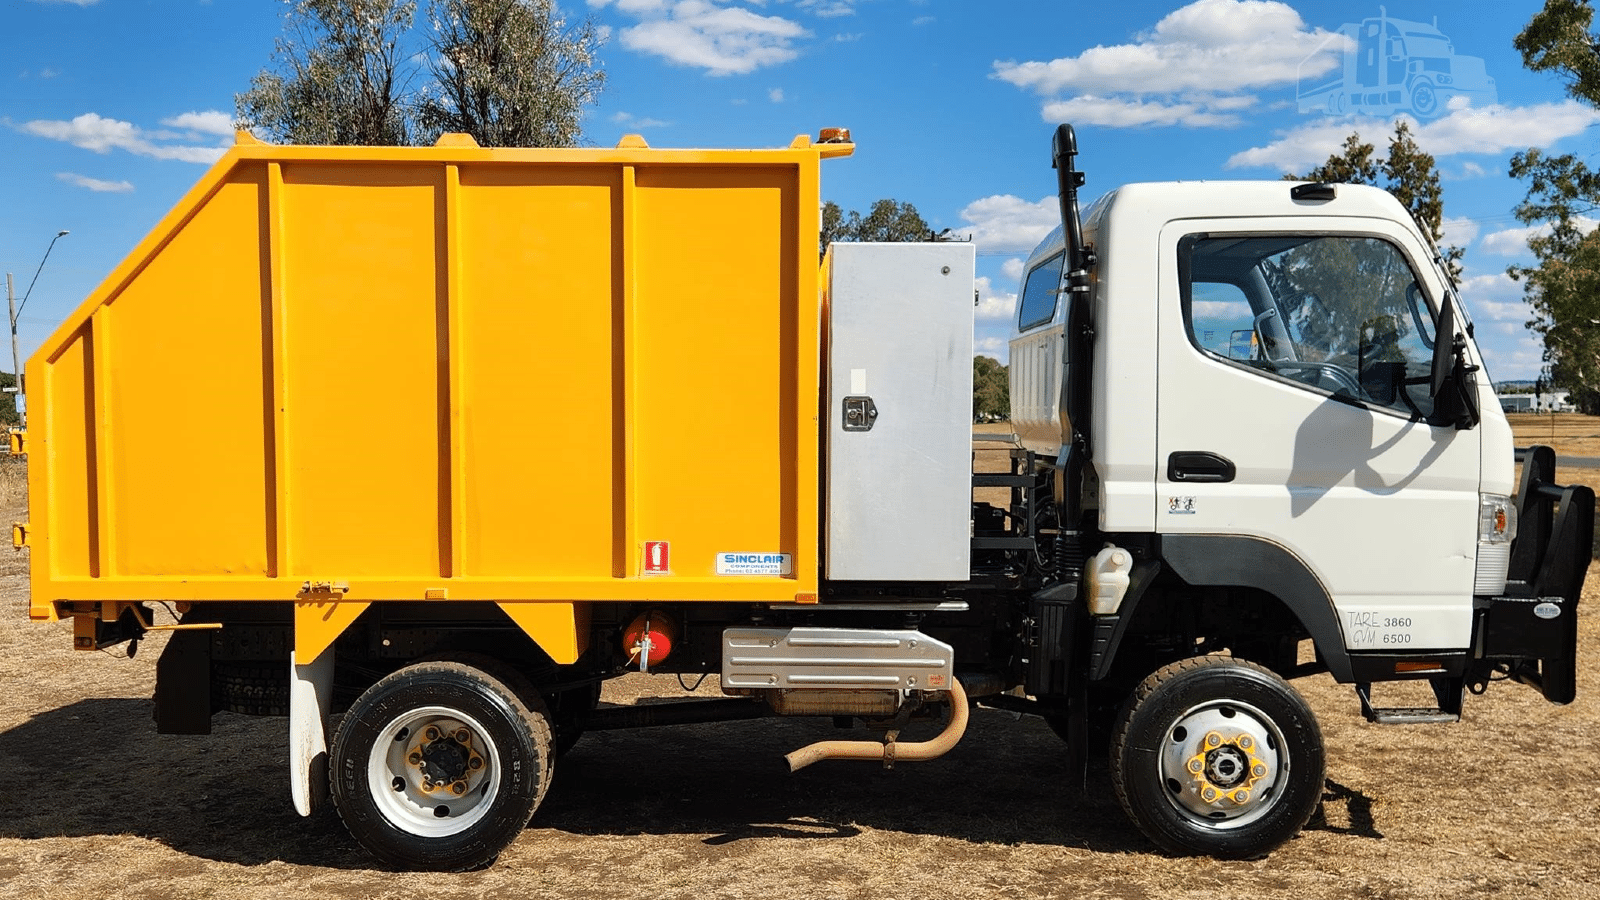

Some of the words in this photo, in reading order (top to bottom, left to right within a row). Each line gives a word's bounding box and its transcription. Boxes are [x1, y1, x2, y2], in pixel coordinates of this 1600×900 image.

[724, 554, 784, 563] SINCLAIR
[1347, 611, 1381, 629] TARE
[1384, 617, 1412, 628] 3860
[1353, 627, 1376, 647] GVM
[1383, 633, 1411, 644] 6500
